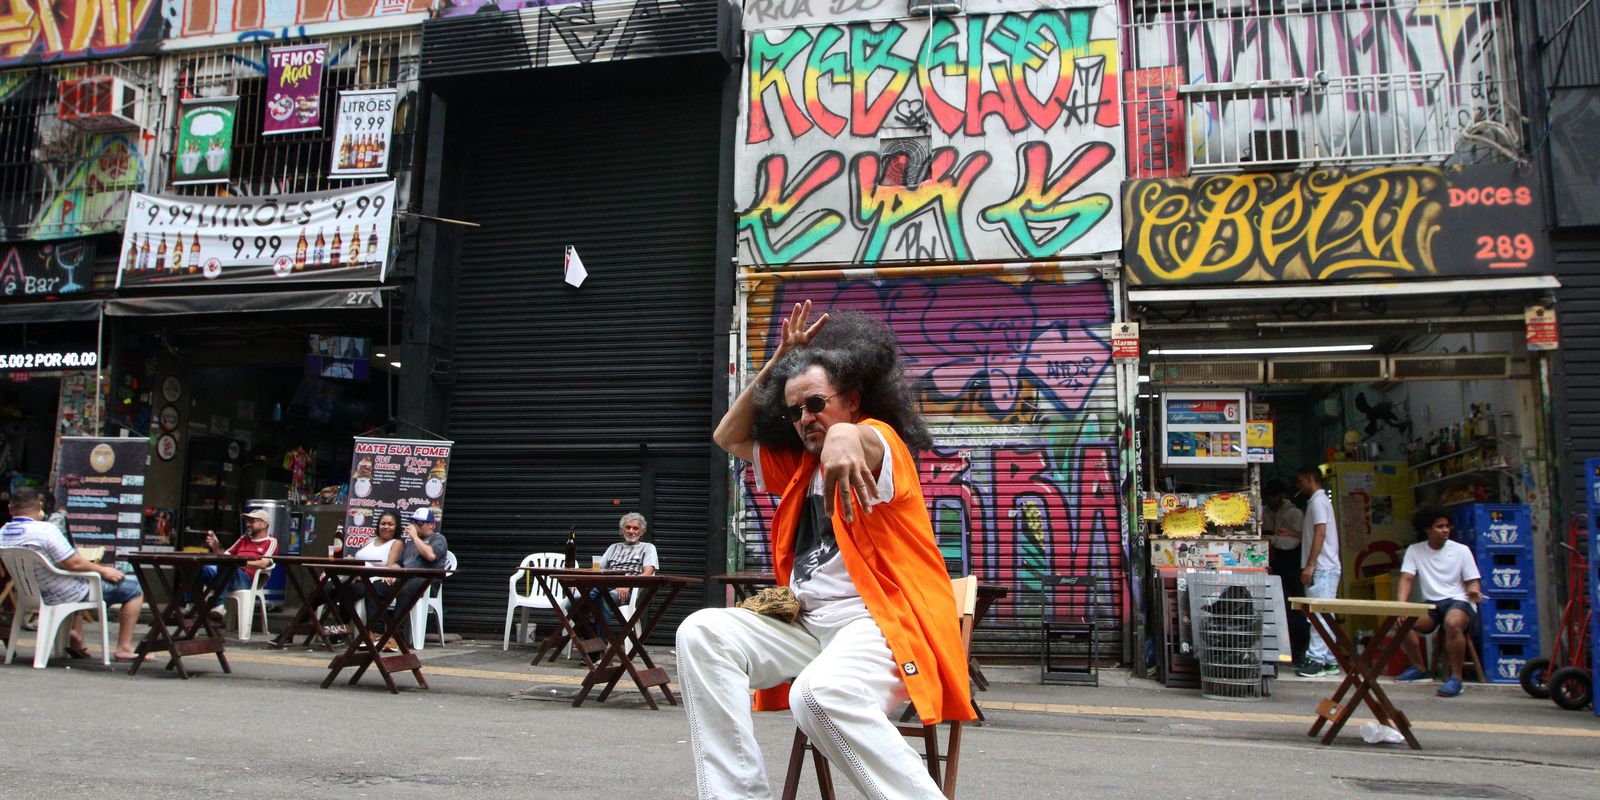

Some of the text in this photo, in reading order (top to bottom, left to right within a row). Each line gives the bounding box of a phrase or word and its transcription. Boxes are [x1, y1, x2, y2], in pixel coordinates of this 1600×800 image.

[272, 50, 325, 68] TEMOS
[342, 97, 392, 114] LITRÕES
[354, 116, 385, 130] 9.99
[148, 204, 194, 226] 9.99
[197, 197, 314, 226] LITRÕES
[332, 195, 386, 219] 9.99
[232, 235, 282, 258] 9.99
[1475, 233, 1534, 260] 289
[25, 276, 60, 294] Bar
[34, 353, 62, 367] POR
[62, 352, 97, 366] 40.00
[1227, 407, 1234, 418] 6
[1257, 429, 1264, 440] 7
[356, 443, 450, 457] MATE SUA FOME!
